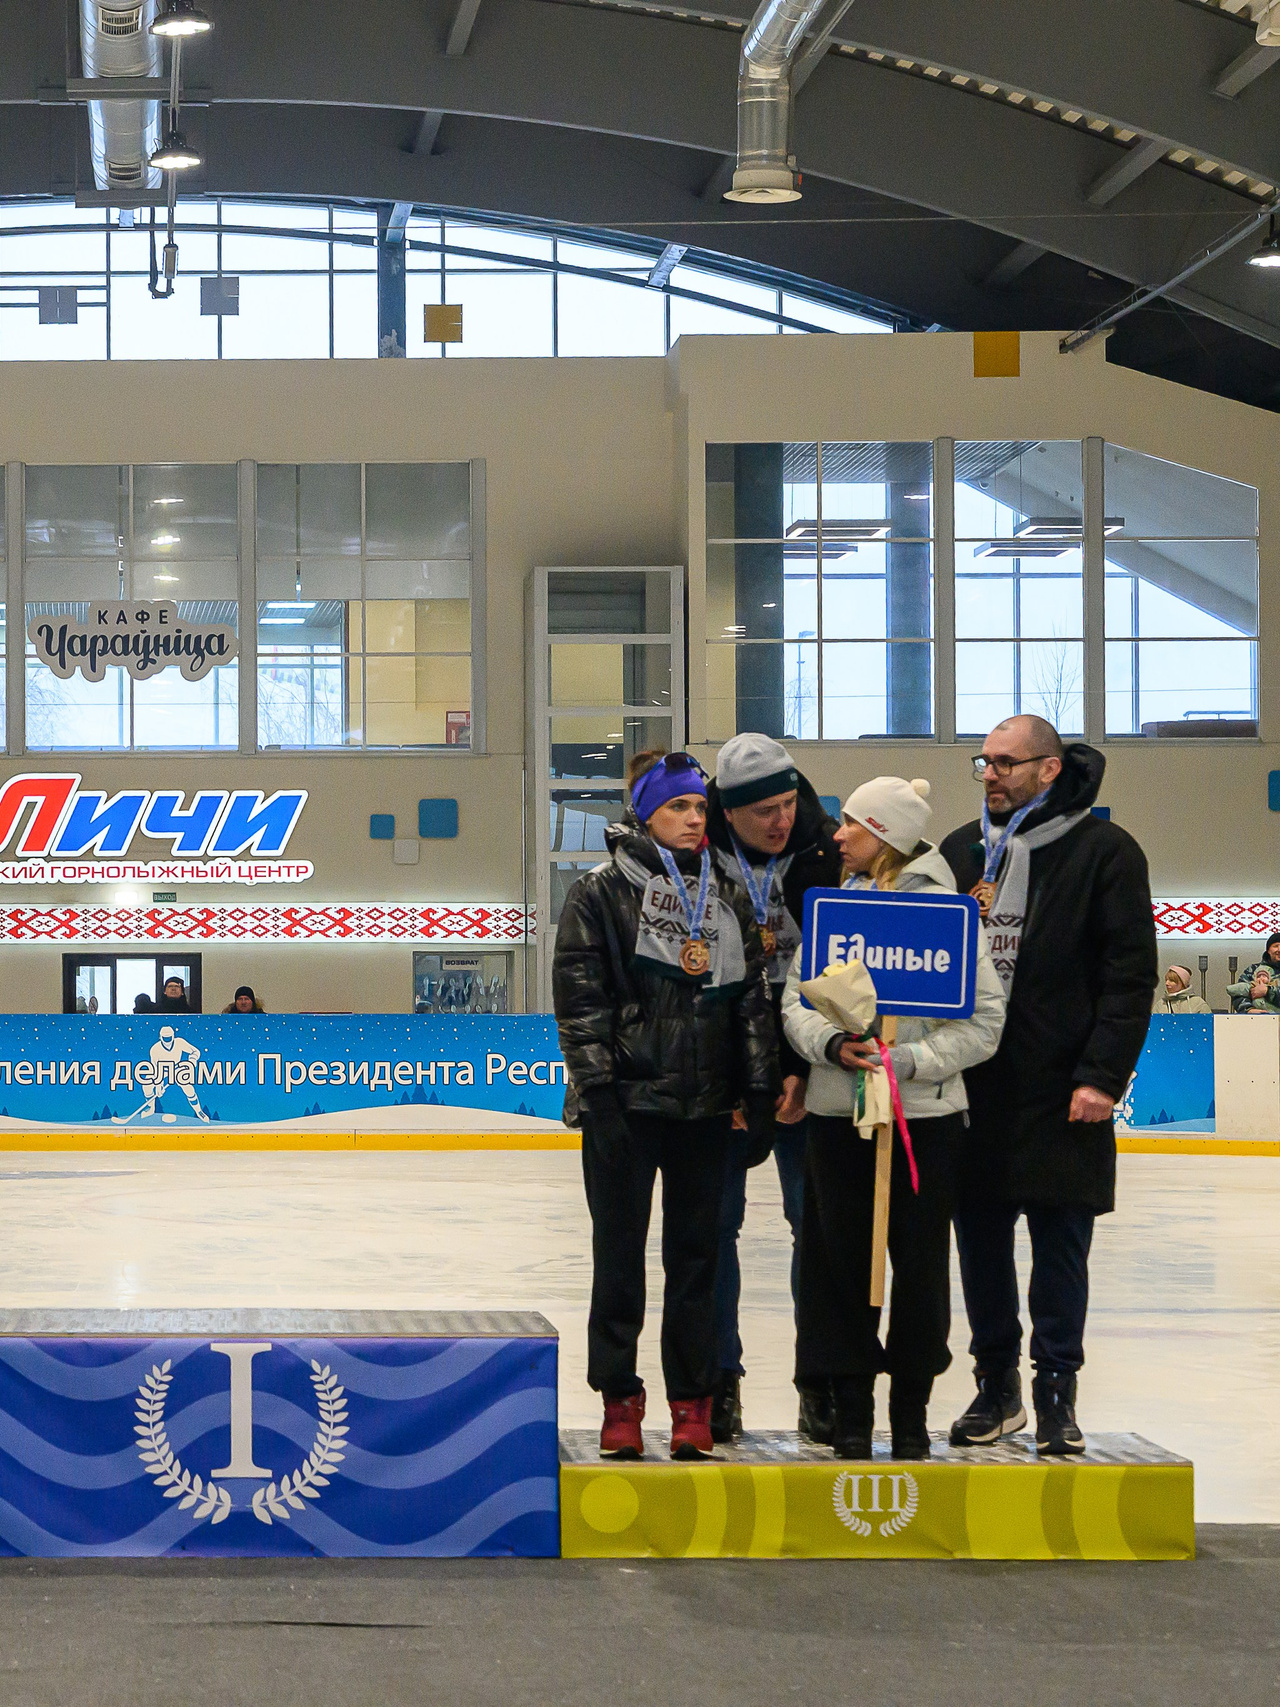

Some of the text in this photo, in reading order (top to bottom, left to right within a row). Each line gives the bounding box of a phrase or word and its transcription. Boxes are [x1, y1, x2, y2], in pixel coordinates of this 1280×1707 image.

[97, 609, 169, 625] КАФЕ
[37, 623, 230, 674] Чараўніца
[50, 862, 231, 878] ГОРНОЛЫЖНЫЙ
[237, 865, 308, 881] ЦЕНТР
[651, 890, 712, 920] ЕДИЕ
[828, 933, 951, 973] Единые
[110, 1060, 247, 1091] делами
[257, 1053, 474, 1093] Президента
[485, 1053, 569, 1085] Респ
[210, 1342, 272, 1478] I
[847, 1474, 905, 1512] III
